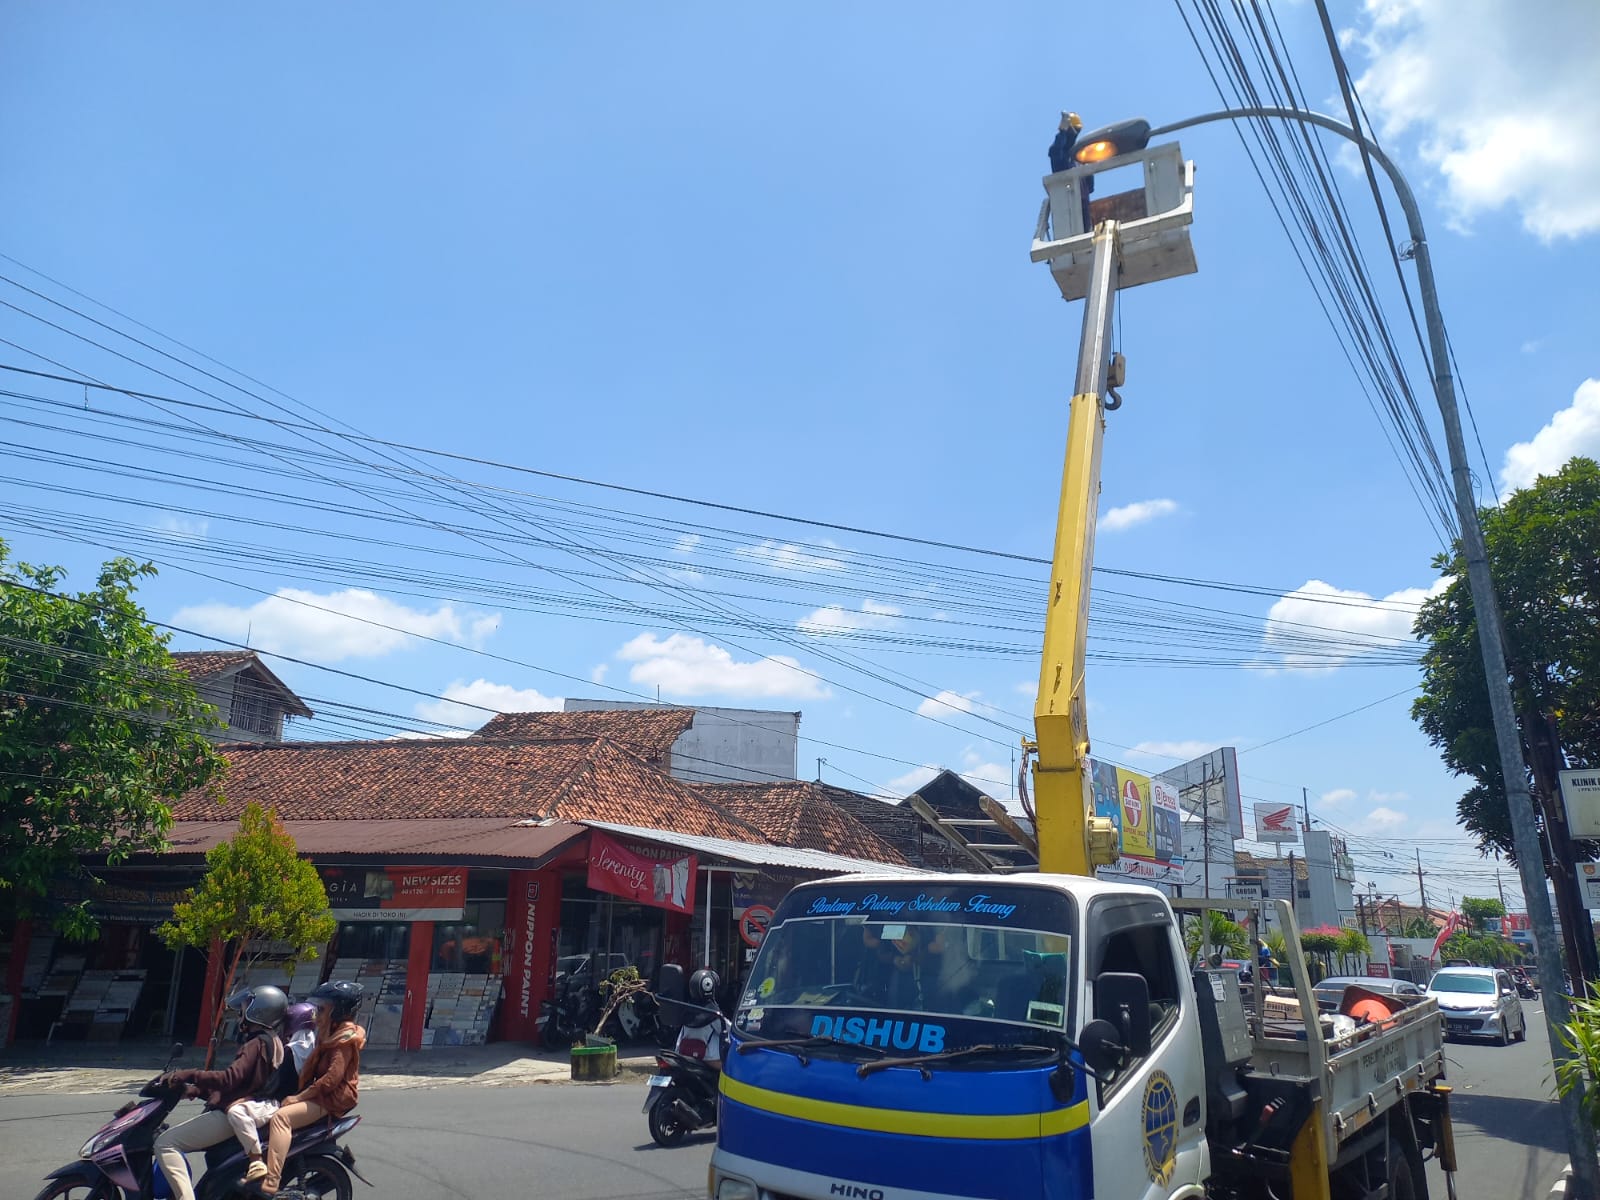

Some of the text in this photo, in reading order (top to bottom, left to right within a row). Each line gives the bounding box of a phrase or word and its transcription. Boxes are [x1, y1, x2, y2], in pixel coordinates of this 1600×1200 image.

[1572, 777, 1597, 787] KLINIK
[402, 875, 462, 886] NEW SIZES
[591, 847, 647, 889] Serenity
[807, 892, 1017, 919] Pantang Pulang Sebelum Terang
[520, 902, 536, 1018] NIPPON PAINT
[810, 1015, 946, 1053] DISHUB
[830, 1183, 884, 1200] HINO
